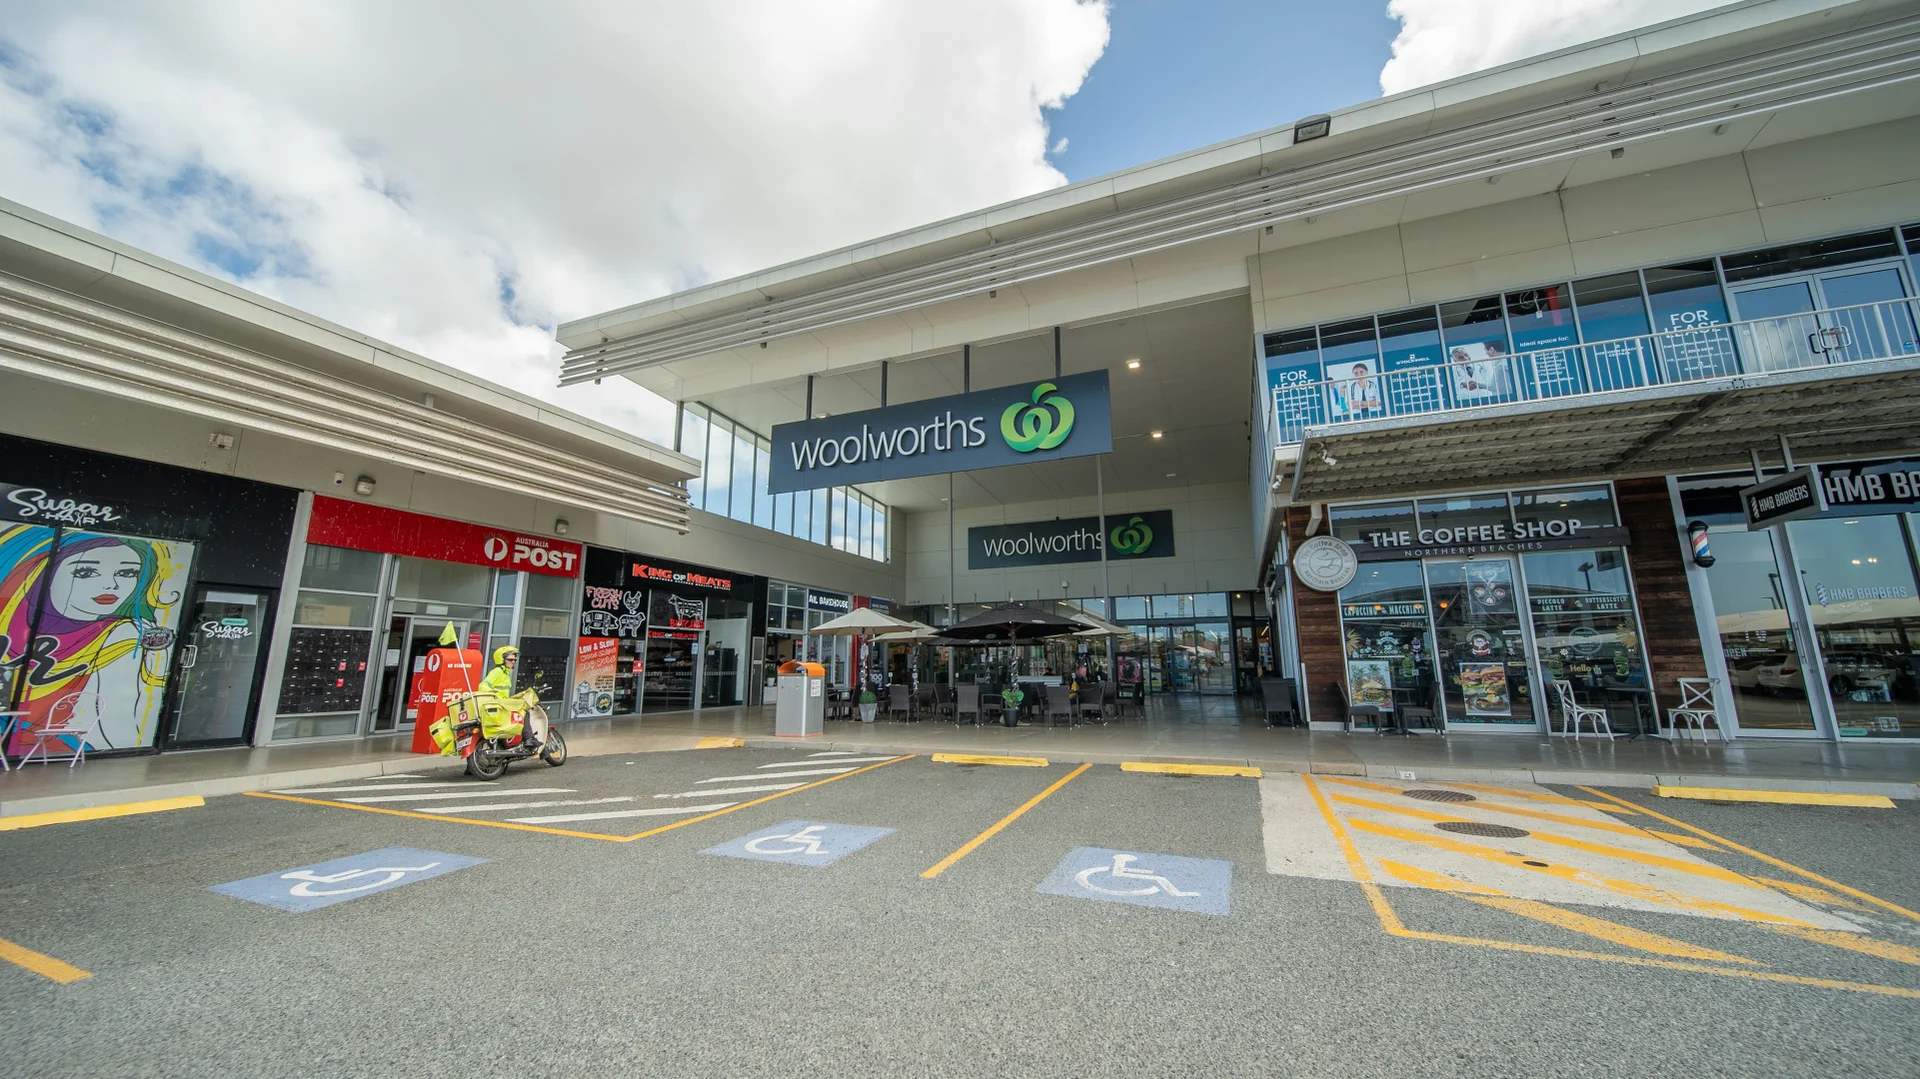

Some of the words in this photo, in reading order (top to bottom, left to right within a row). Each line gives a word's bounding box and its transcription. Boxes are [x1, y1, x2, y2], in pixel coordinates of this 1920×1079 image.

[1670, 310, 1709, 325] FOR
[1665, 320, 1721, 338] LEASE
[1280, 370, 1308, 382] FOR
[1824, 474, 1886, 503] HMB
[7, 488, 122, 522] Sugar
[1758, 498, 1775, 512] HMB
[1775, 484, 1809, 507] BARBERS
[1369, 531, 1411, 548] THE
[1418, 524, 1506, 546] COFFEE
[1513, 519, 1582, 539] SHOP
[515, 537, 549, 549] AUSTRALIA
[1404, 546, 1476, 557] NORTHERN
[1481, 541, 1543, 553] BEACHES
[513, 544, 577, 571] POST
[632, 563, 672, 579] KING
[672, 573, 687, 581] OF
[687, 572, 732, 588] MEATS
[586, 586, 623, 600] FRESH
[1829, 587, 1855, 600] HMB
[1856, 585, 1907, 599] BARBERS
[591, 597, 619, 610] CUTS
[201, 621, 252, 638] Sugar
[1569, 664, 1592, 672] Hello
[421, 694, 438, 703] POST
